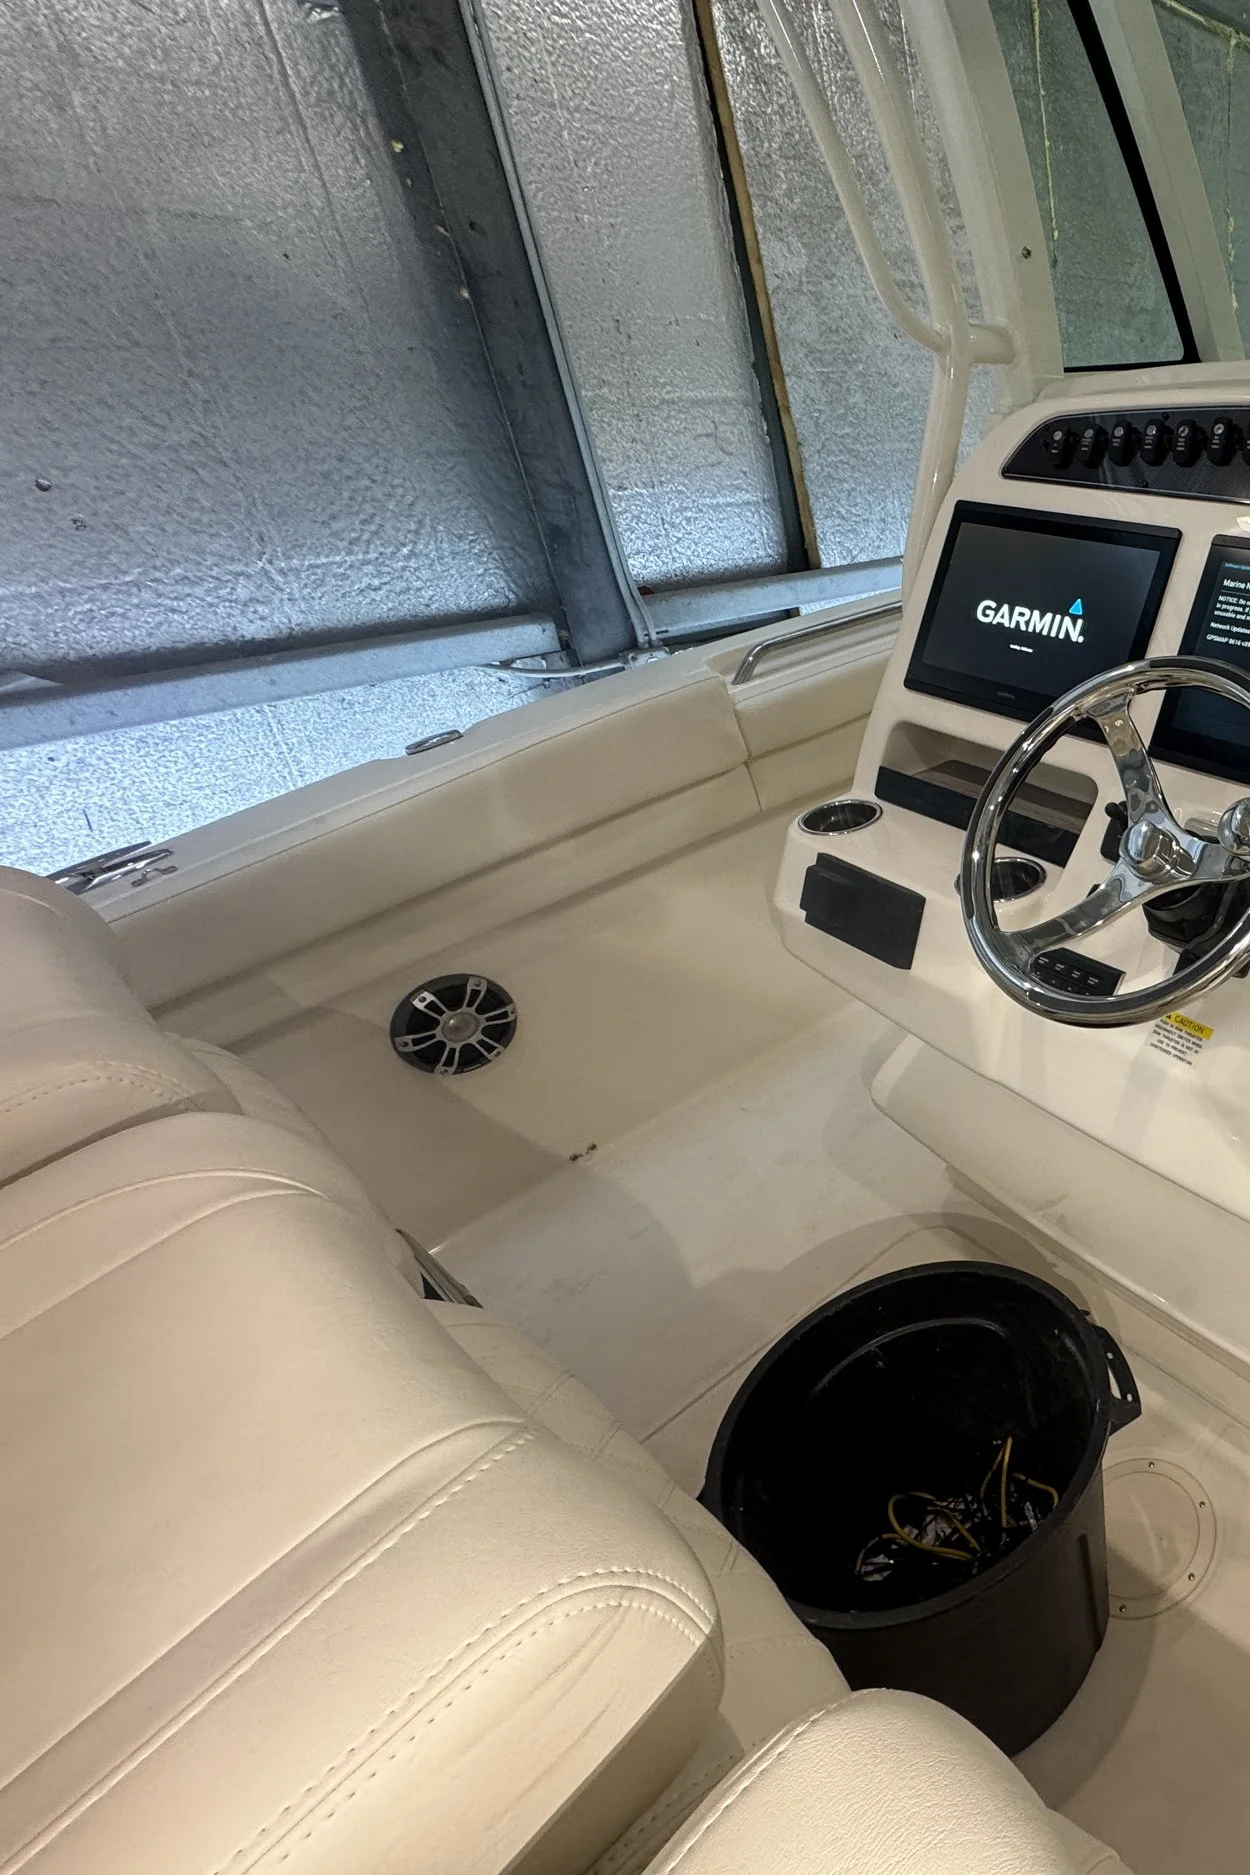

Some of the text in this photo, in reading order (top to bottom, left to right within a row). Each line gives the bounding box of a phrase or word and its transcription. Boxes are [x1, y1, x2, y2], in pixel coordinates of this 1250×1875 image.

[1223, 579, 1246, 589] Marine
[1218, 595, 1238, 604] NOTICE:
[1221, 604, 1243, 612] progress.
[1214, 610, 1236, 618] unusable
[1210, 622, 1230, 630] Network
[1231, 625, 1250, 634] Updates
[1206, 634, 1228, 643] GPSMAP
[1174, 1015, 1205, 1034] CAUTION
